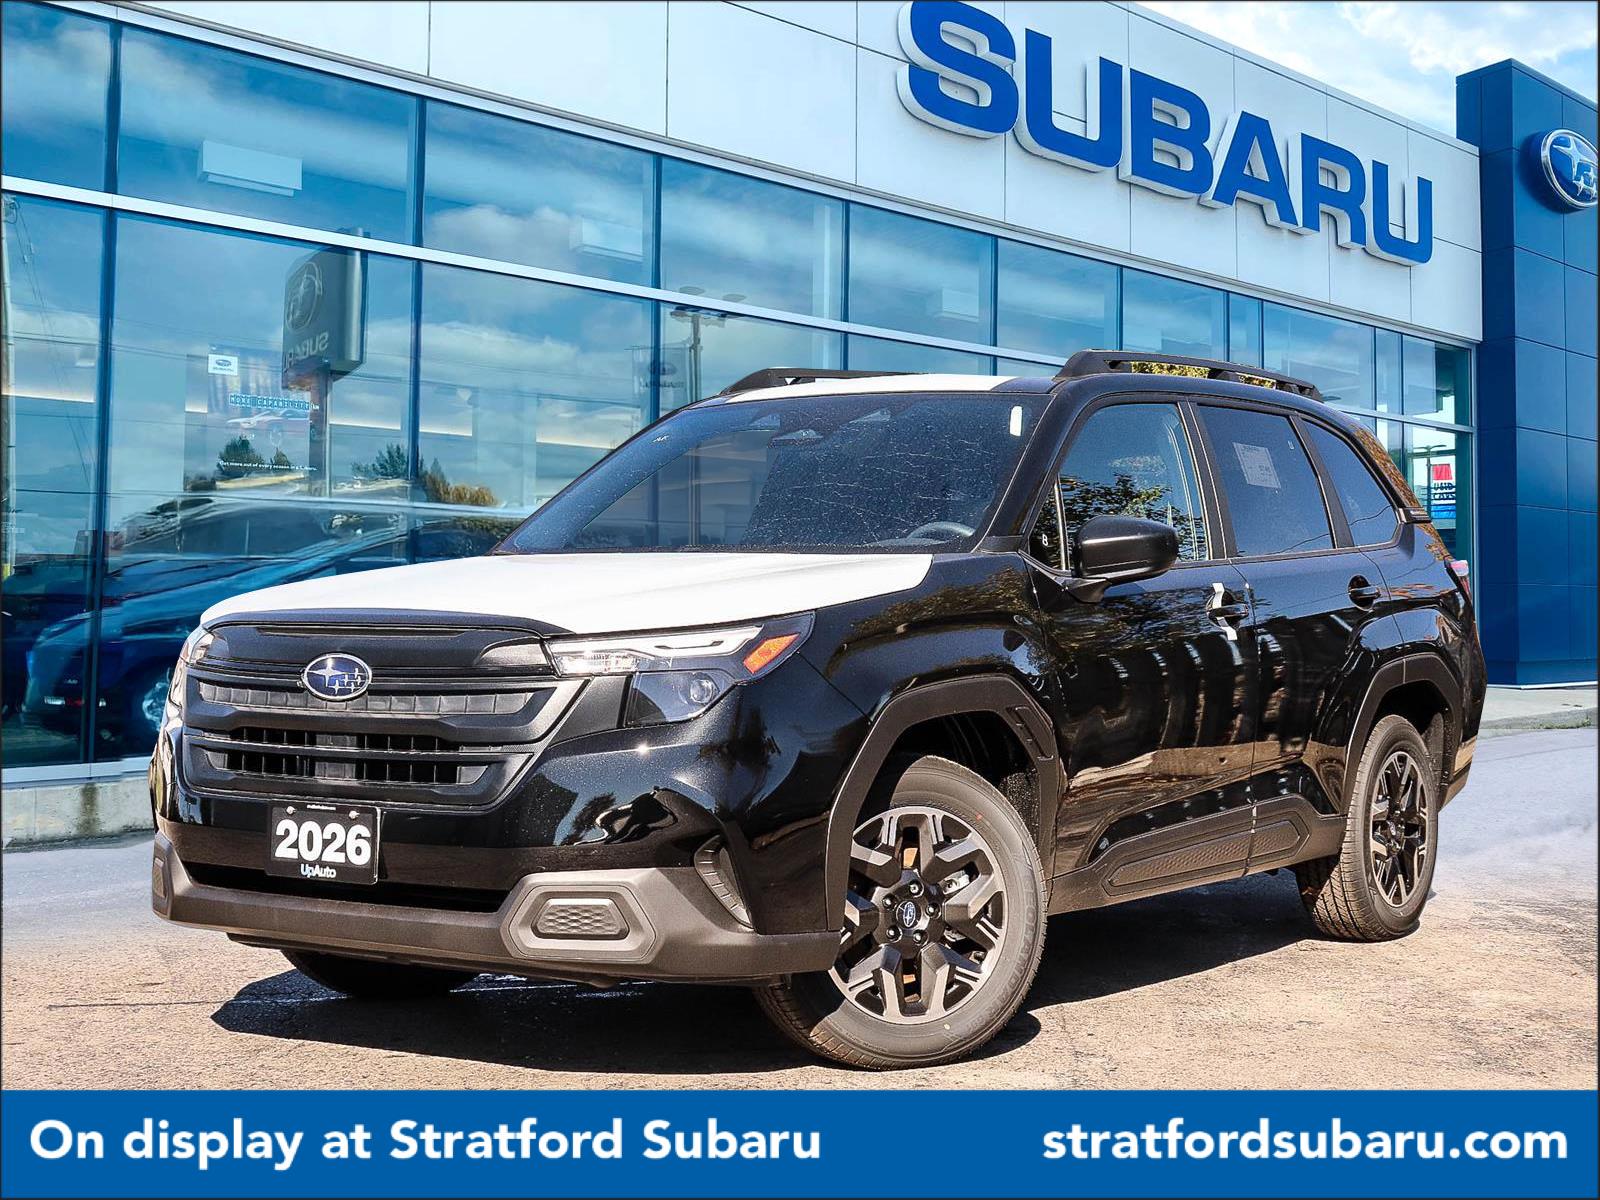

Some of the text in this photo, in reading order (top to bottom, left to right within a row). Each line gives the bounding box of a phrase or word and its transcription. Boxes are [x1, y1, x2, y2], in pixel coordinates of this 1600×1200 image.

[897, 0, 1433, 265] SUBARU
[275, 819, 372, 866] 2026
[300, 863, 337, 879] UpAuto
